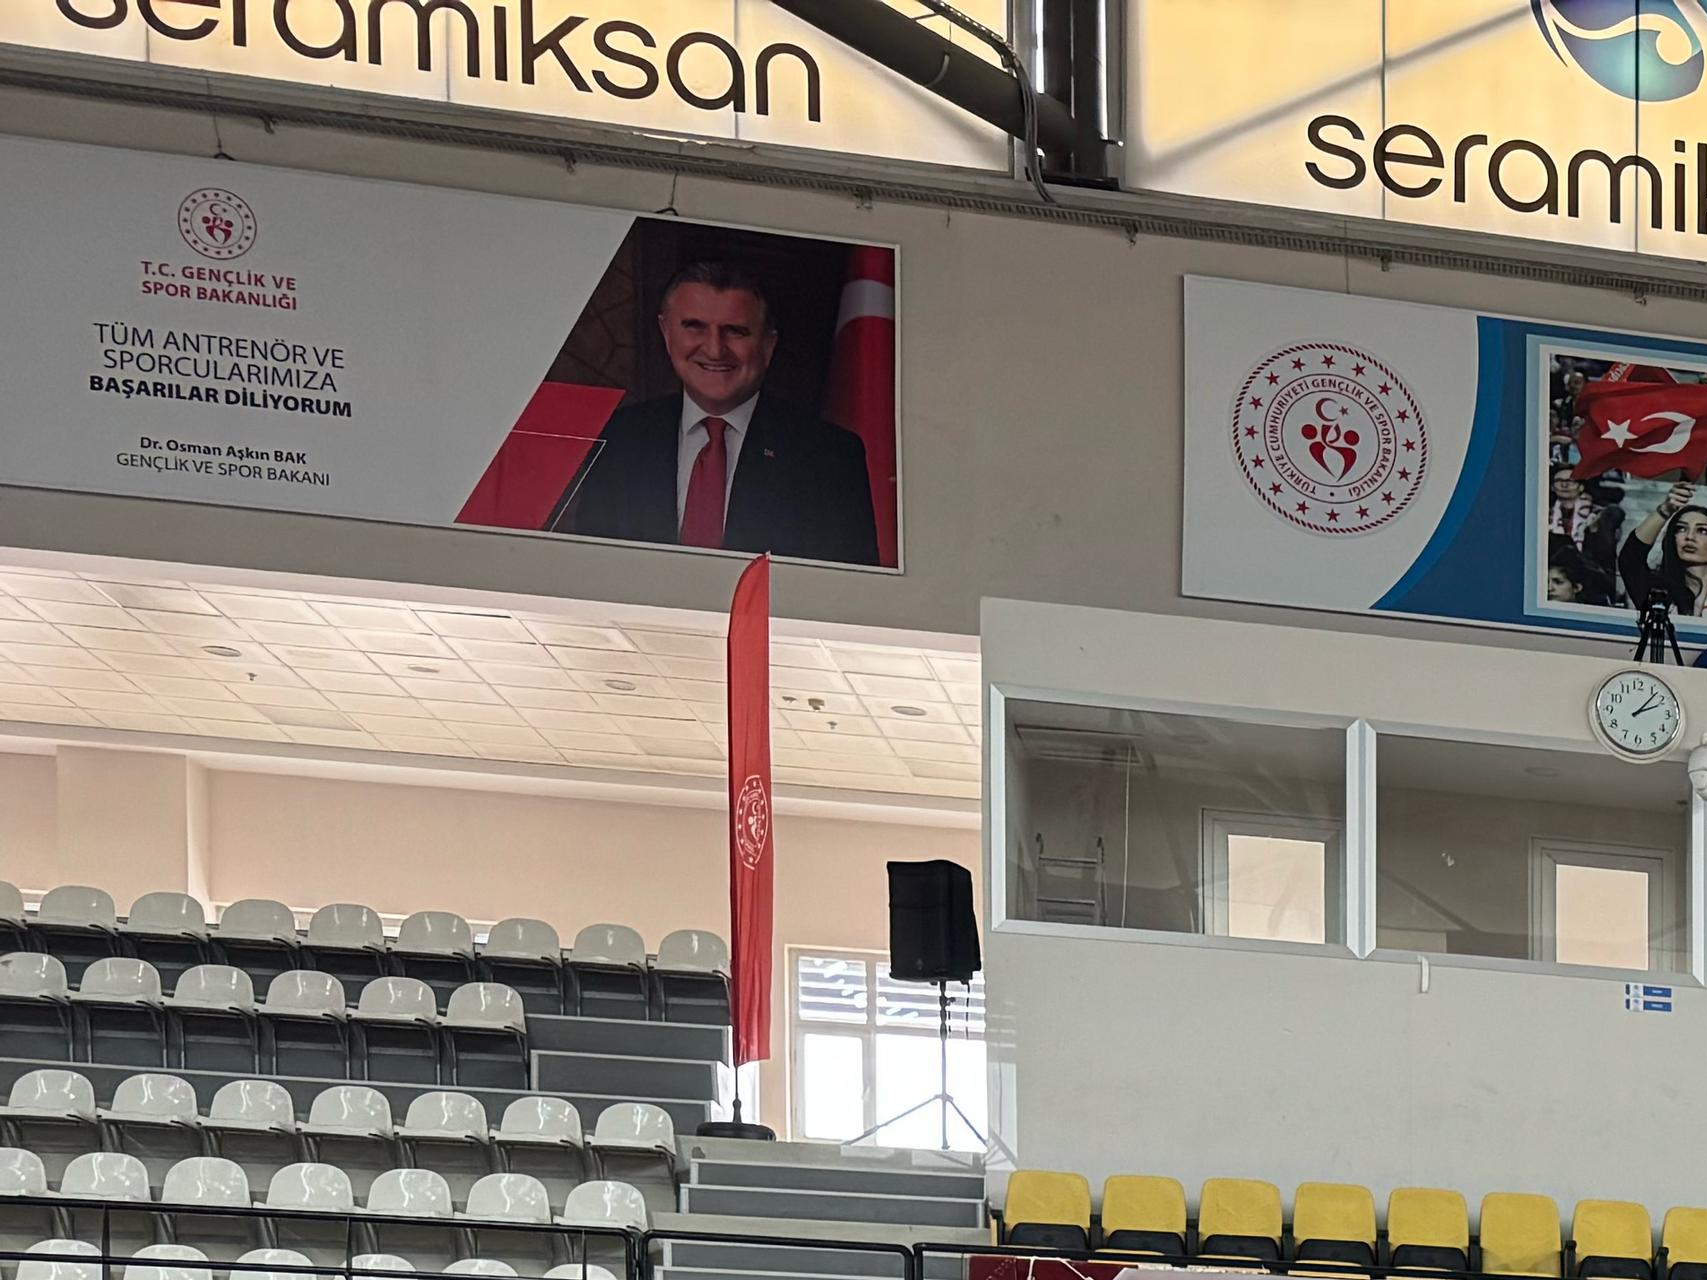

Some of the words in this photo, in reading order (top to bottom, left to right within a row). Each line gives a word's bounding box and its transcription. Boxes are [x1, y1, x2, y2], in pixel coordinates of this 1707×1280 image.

[141, 261, 175, 277] T.C.
[182, 266, 265, 288] GENÇLİK
[271, 275, 297, 291] VE
[141, 281, 191, 299] SPOR
[197, 287, 297, 310] BAKANLIĞI
[93, 321, 154, 349] TÜM
[162, 331, 307, 365] ANTRENÖR
[311, 346, 345, 369] VE
[103, 349, 338, 392] SPORCULARIMIZA
[89, 375, 219, 404] BAŞARILAR
[224, 388, 352, 418] DİLİYORUM
[1312, 377, 1364, 399] GENÇLİK
[1364, 396, 1379, 412] VE
[1268, 379, 1310, 451] CUMHURİYETİ
[1376, 413, 1392, 445] SPOR
[140, 436, 162, 451] Dr.
[166, 439, 221, 457] Osman
[226, 445, 270, 461] Aşkın
[274, 450, 307, 465] BAK
[116, 452, 189, 473] GENÇLİK
[192, 460, 213, 475] VE
[218, 462, 262, 480] SPOR
[267, 467, 330, 487] BAKANI
[1274, 452, 1318, 495] TÜRKİYE
[1348, 447, 1392, 497] BAKANLIĞI
[1632, 680, 1644, 691] 12
